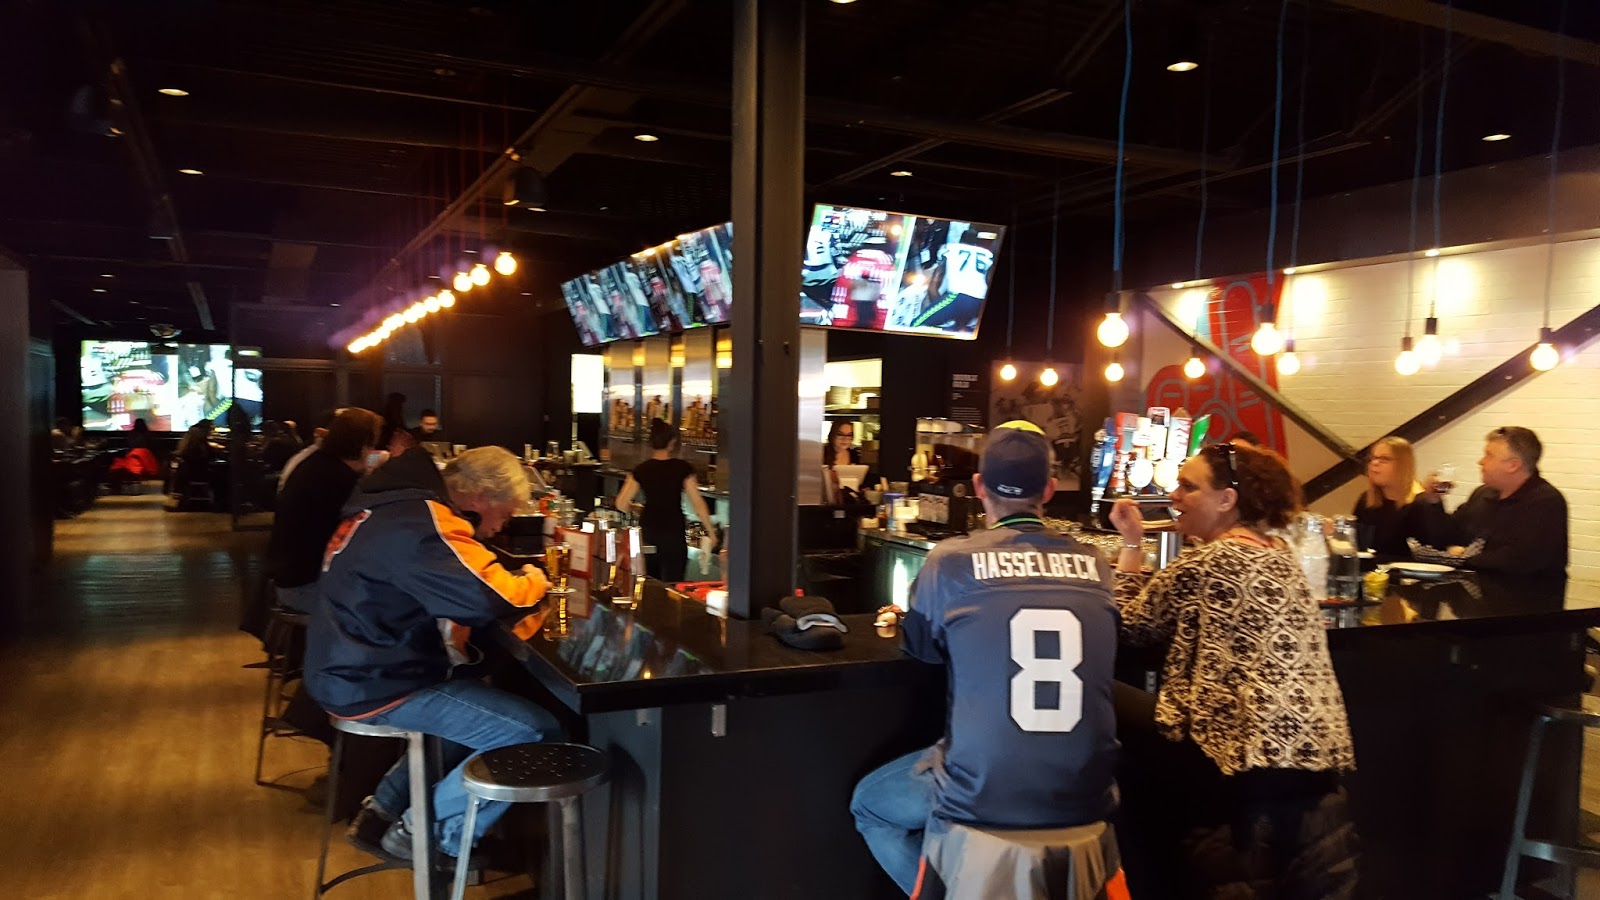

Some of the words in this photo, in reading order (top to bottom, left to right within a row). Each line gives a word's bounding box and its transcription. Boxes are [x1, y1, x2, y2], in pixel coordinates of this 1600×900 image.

[959, 250, 987, 275] 76
[972, 552, 1101, 581] HASSELBECK
[1010, 608, 1083, 732] 8
